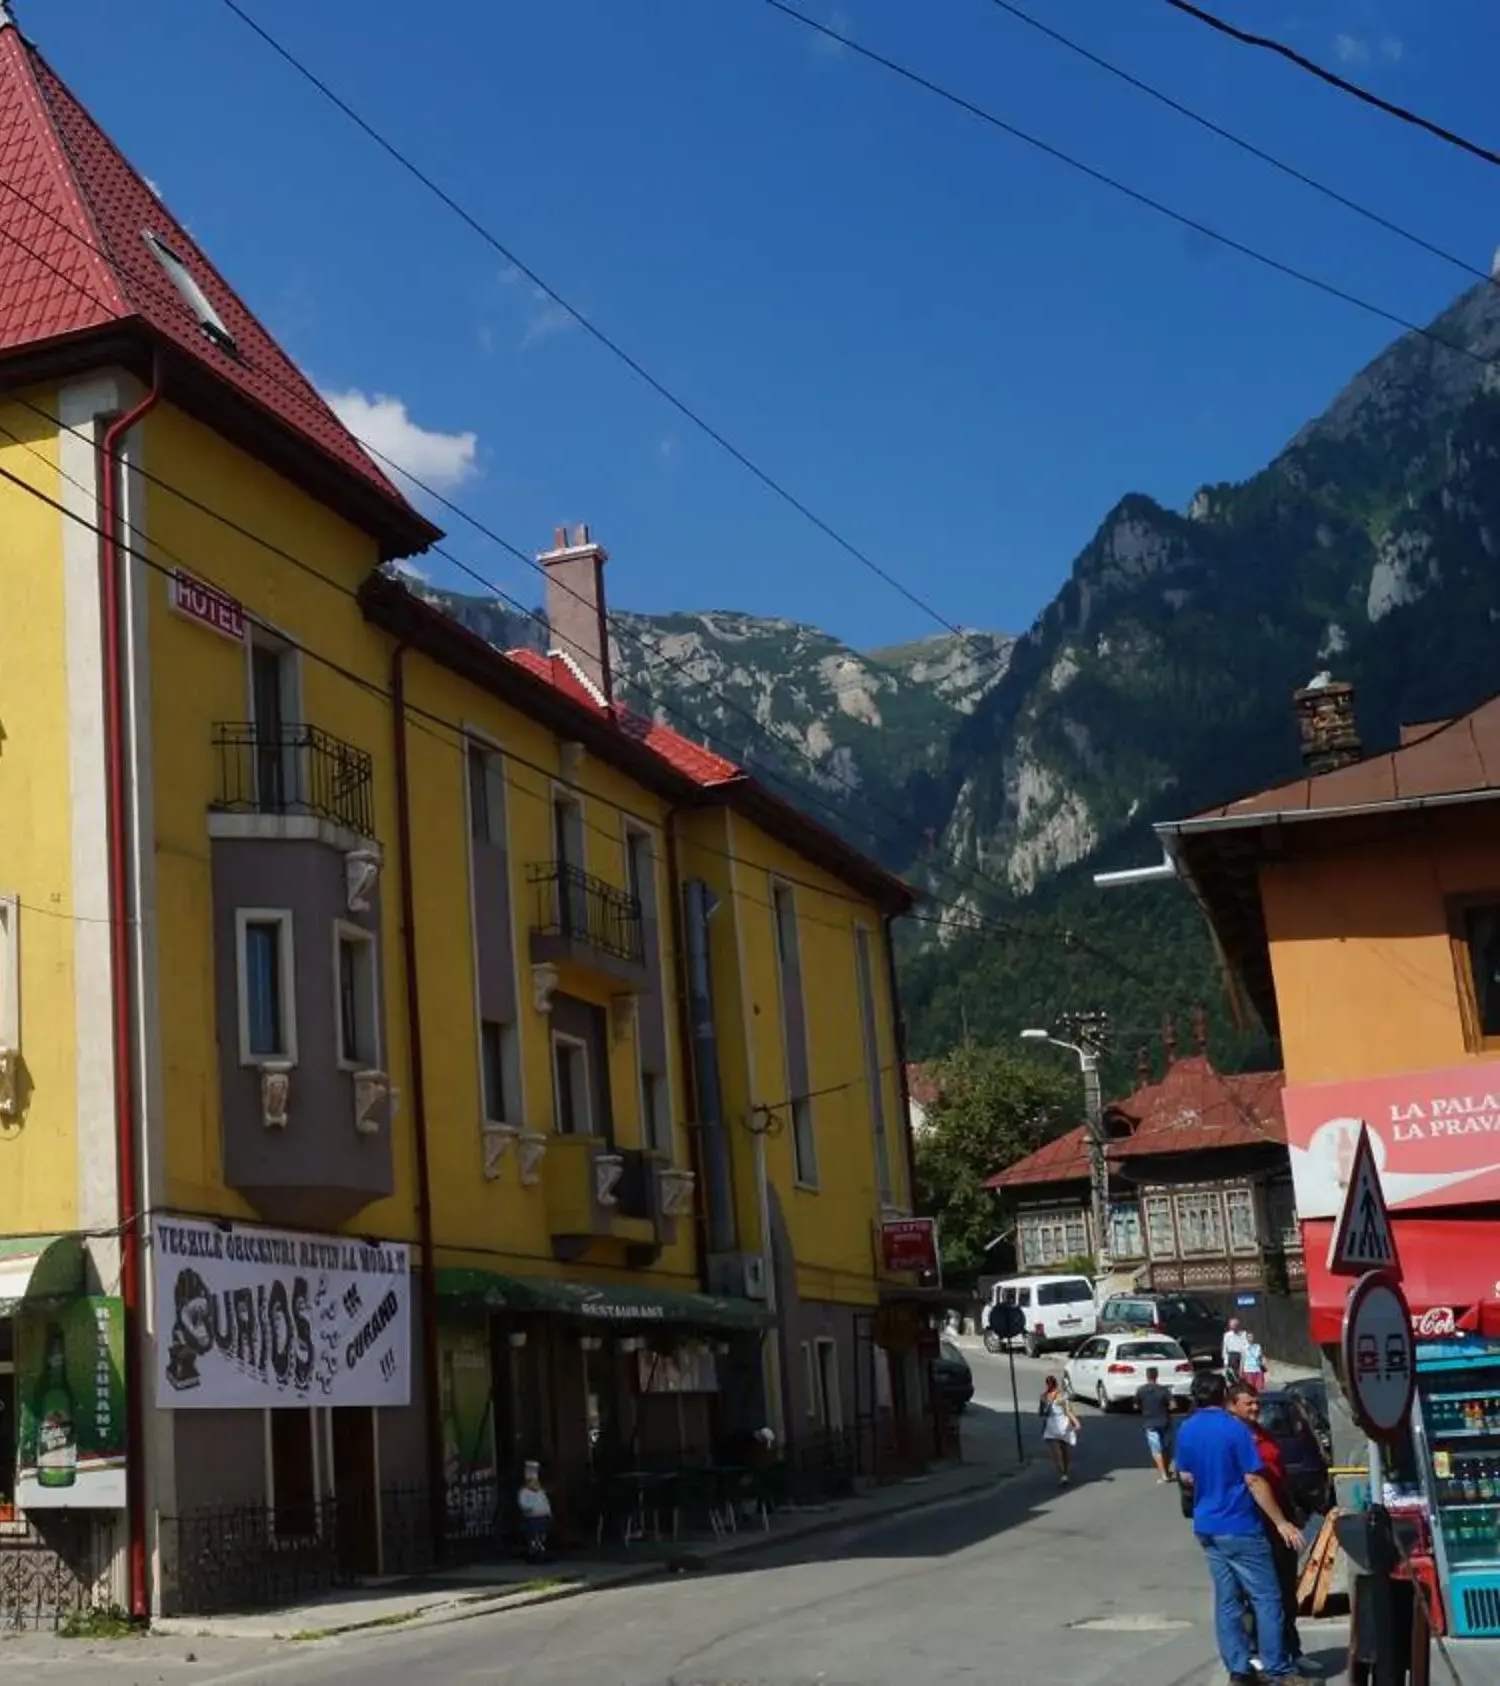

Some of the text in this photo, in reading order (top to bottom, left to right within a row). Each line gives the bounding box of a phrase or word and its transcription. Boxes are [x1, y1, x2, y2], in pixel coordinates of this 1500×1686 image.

[178, 578, 243, 635] HOTEL
[1390, 1102, 1425, 1121] LA
[1393, 1123, 1425, 1141] LA
[157, 1225, 223, 1260] VECHILE
[299, 1241, 339, 1270] REVIN
[341, 1246, 359, 1271] LA
[345, 1290, 398, 1369] CURAND
[581, 1303, 665, 1319] RESTAURANT
[95, 1306, 111, 1438] RESTAURANT
